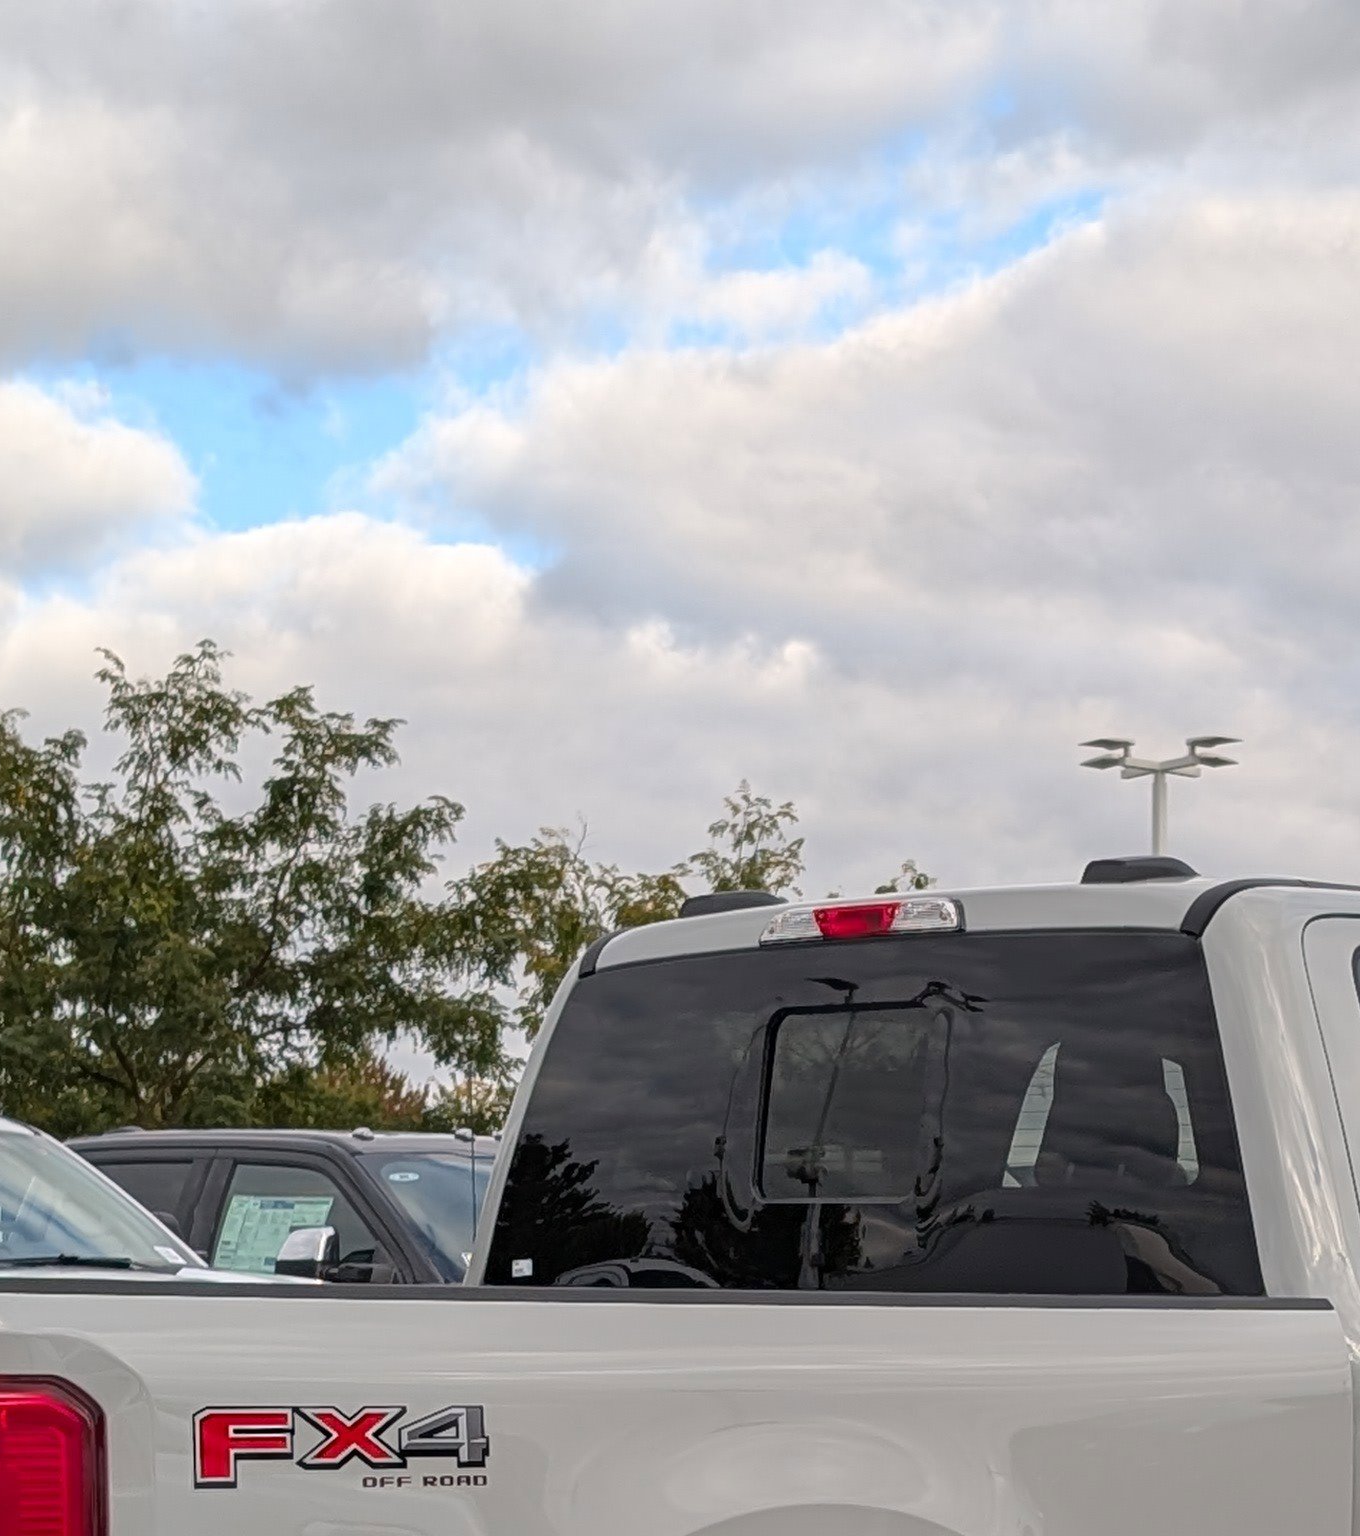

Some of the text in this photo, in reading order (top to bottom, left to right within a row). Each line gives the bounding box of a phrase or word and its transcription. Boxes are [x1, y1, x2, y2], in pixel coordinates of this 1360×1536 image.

[192, 1406, 490, 1489] FX4
[361, 1474, 489, 1489] OFF ROAD
